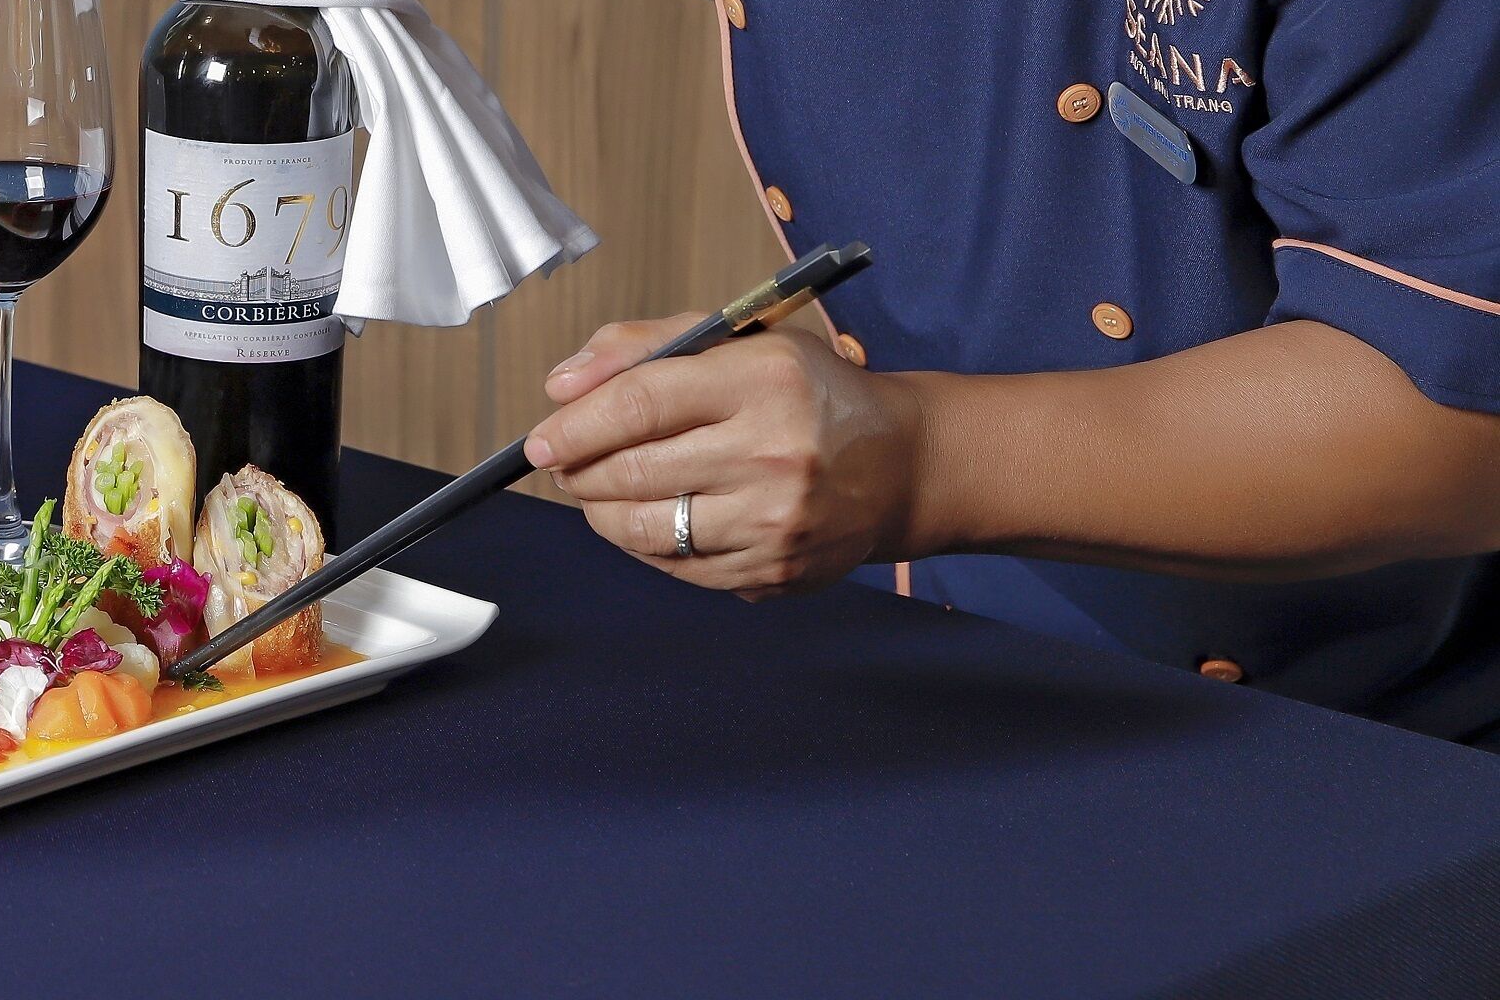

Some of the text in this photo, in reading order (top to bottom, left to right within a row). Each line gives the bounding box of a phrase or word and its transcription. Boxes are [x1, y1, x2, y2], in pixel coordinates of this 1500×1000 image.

[1173, 94, 1233, 114] TRANG
[223, 158, 263, 166] PRODUIT
[281, 156, 312, 165] FRANCE
[166, 178, 349, 265] 1679
[201, 301, 321, 322] CORBIÈRES
[184, 330, 239, 342] APPELLATION
[243, 332, 291, 342] CORBIÈRES
[236, 347, 291, 358] RÉSERVE
